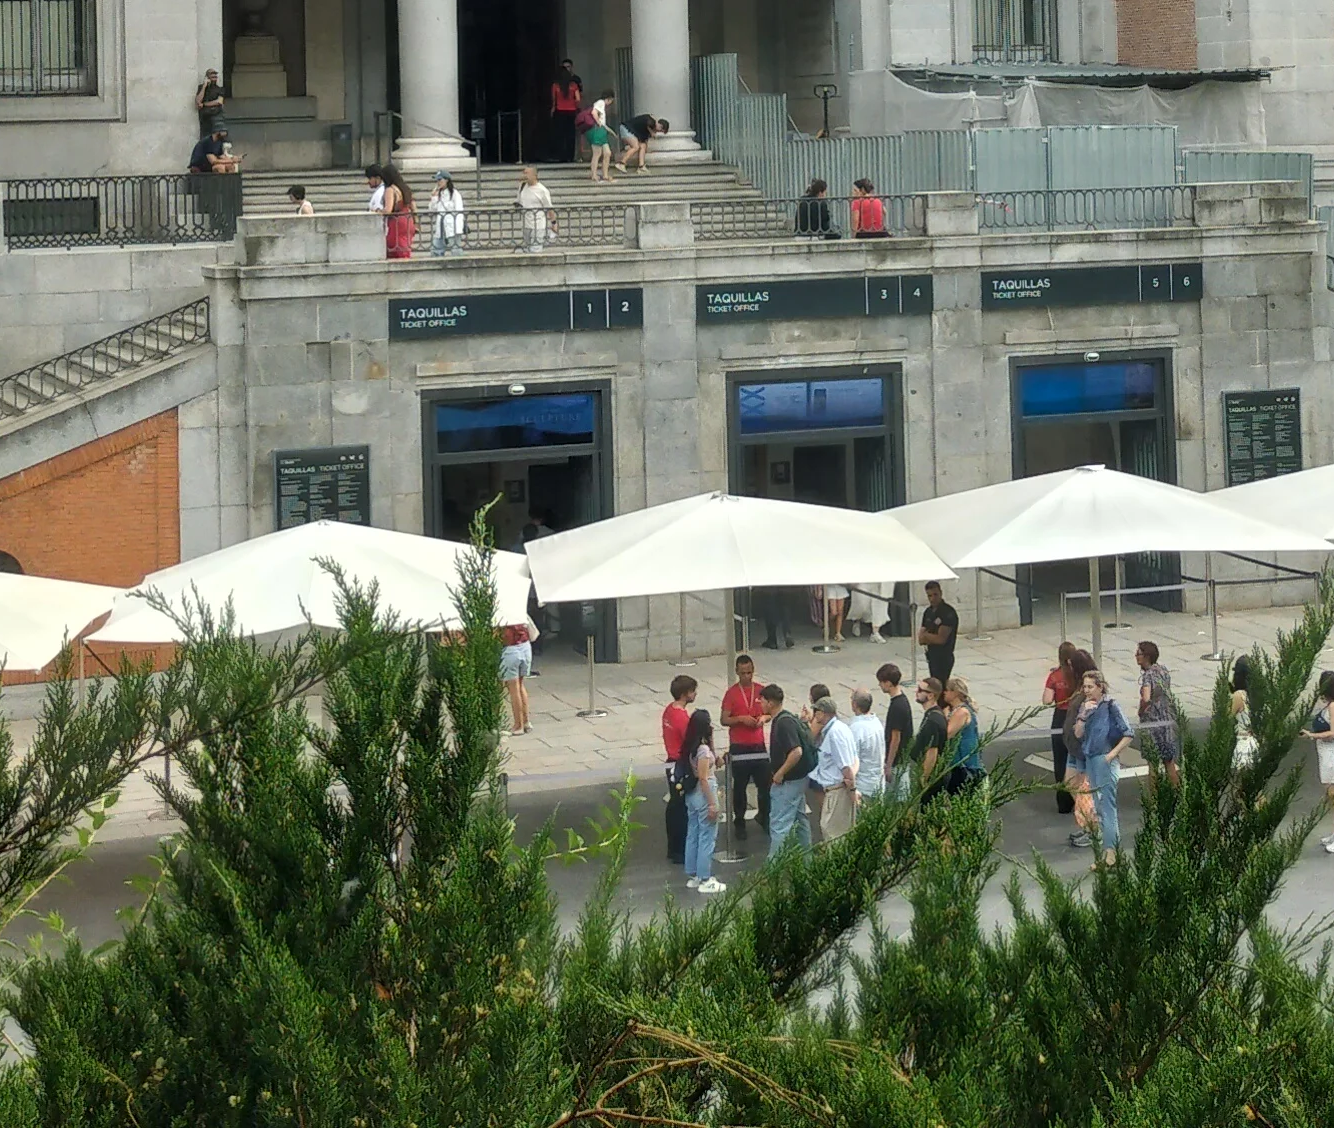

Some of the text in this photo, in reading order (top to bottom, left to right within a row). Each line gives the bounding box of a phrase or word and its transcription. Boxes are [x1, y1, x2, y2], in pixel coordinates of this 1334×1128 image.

[992, 278, 1051, 290] TAQUILLAS
[1152, 277, 1190, 288] 5 6
[707, 291, 770, 304] TAQUILLAS
[881, 288, 921, 299] 3 4
[992, 290, 1042, 299] TICKET OFFICE
[399, 305, 468, 319] TAQUILLAS
[587, 301, 630, 313] 1 2
[707, 303, 760, 313] TICKET OFFICE
[400, 318, 457, 329] TICKET OFFICE
[280, 462, 365, 474] TAQUILLAS TICKET OFFICE
